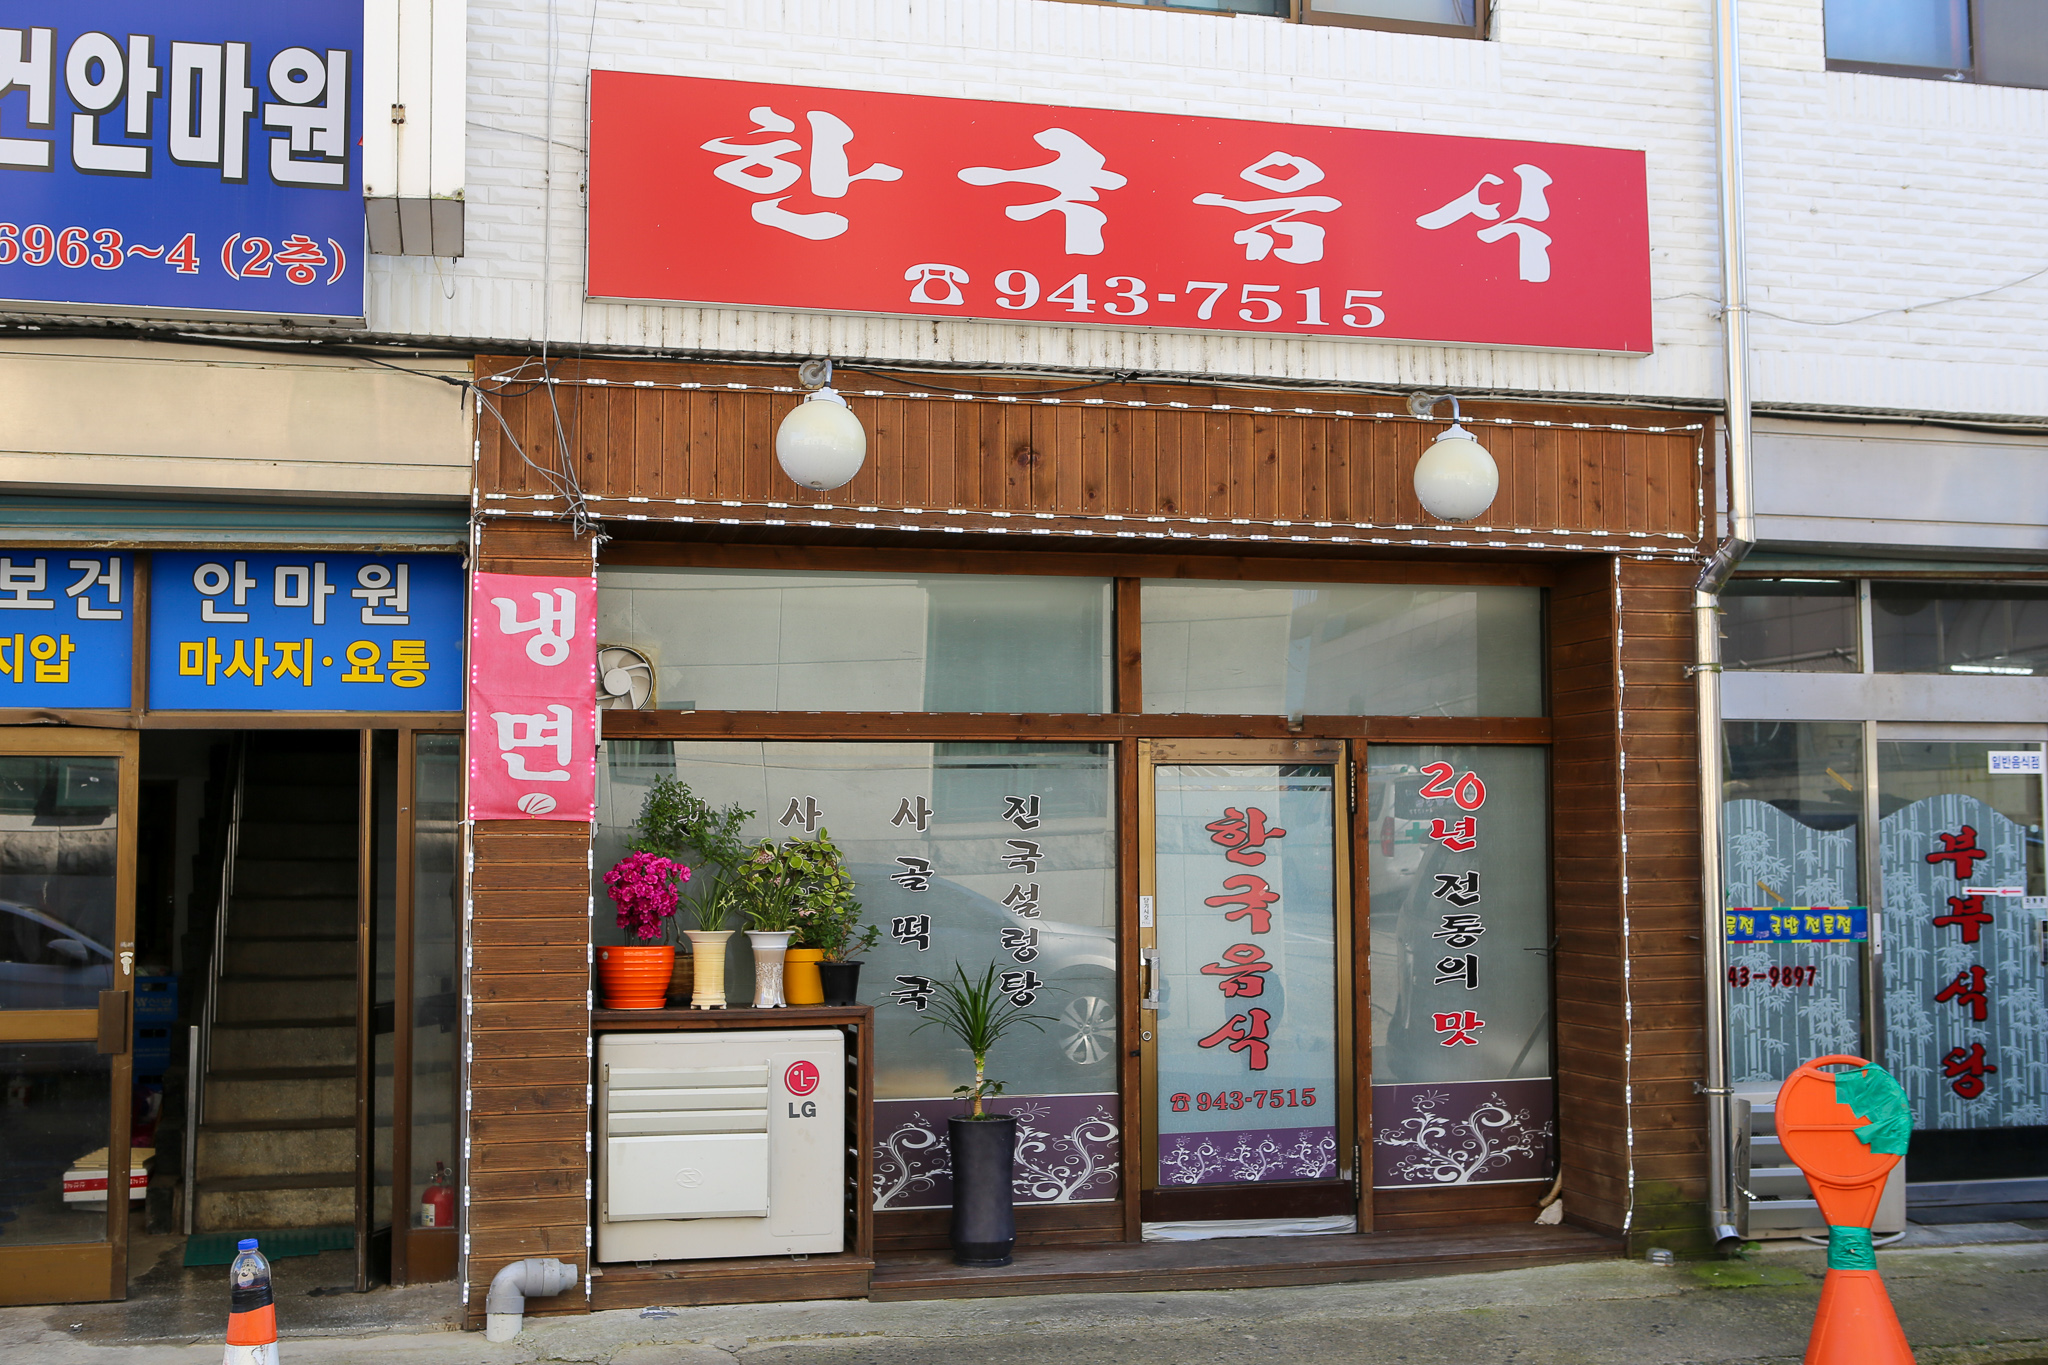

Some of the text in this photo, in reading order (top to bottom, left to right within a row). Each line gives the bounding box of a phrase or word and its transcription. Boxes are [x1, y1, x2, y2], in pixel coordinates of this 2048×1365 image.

[221, 232, 347, 286] (2층)
[993, 269, 1386, 329] 943-7515
[490, 587, 577, 782] 냉면
[1992, 755, 2040, 769] 일반음식점
[1000, 794, 1044, 1008] 진국설렁탕
[1804, 914, 1852, 935] 전문점
[1198, 807, 1287, 1071] 한국음식
[1926, 825, 1997, 1099] 부부식당
[1727, 965, 1817, 988] 43-9897
[788, 1101, 816, 1118] LG
[1196, 1088, 1317, 1112] 943-7515
